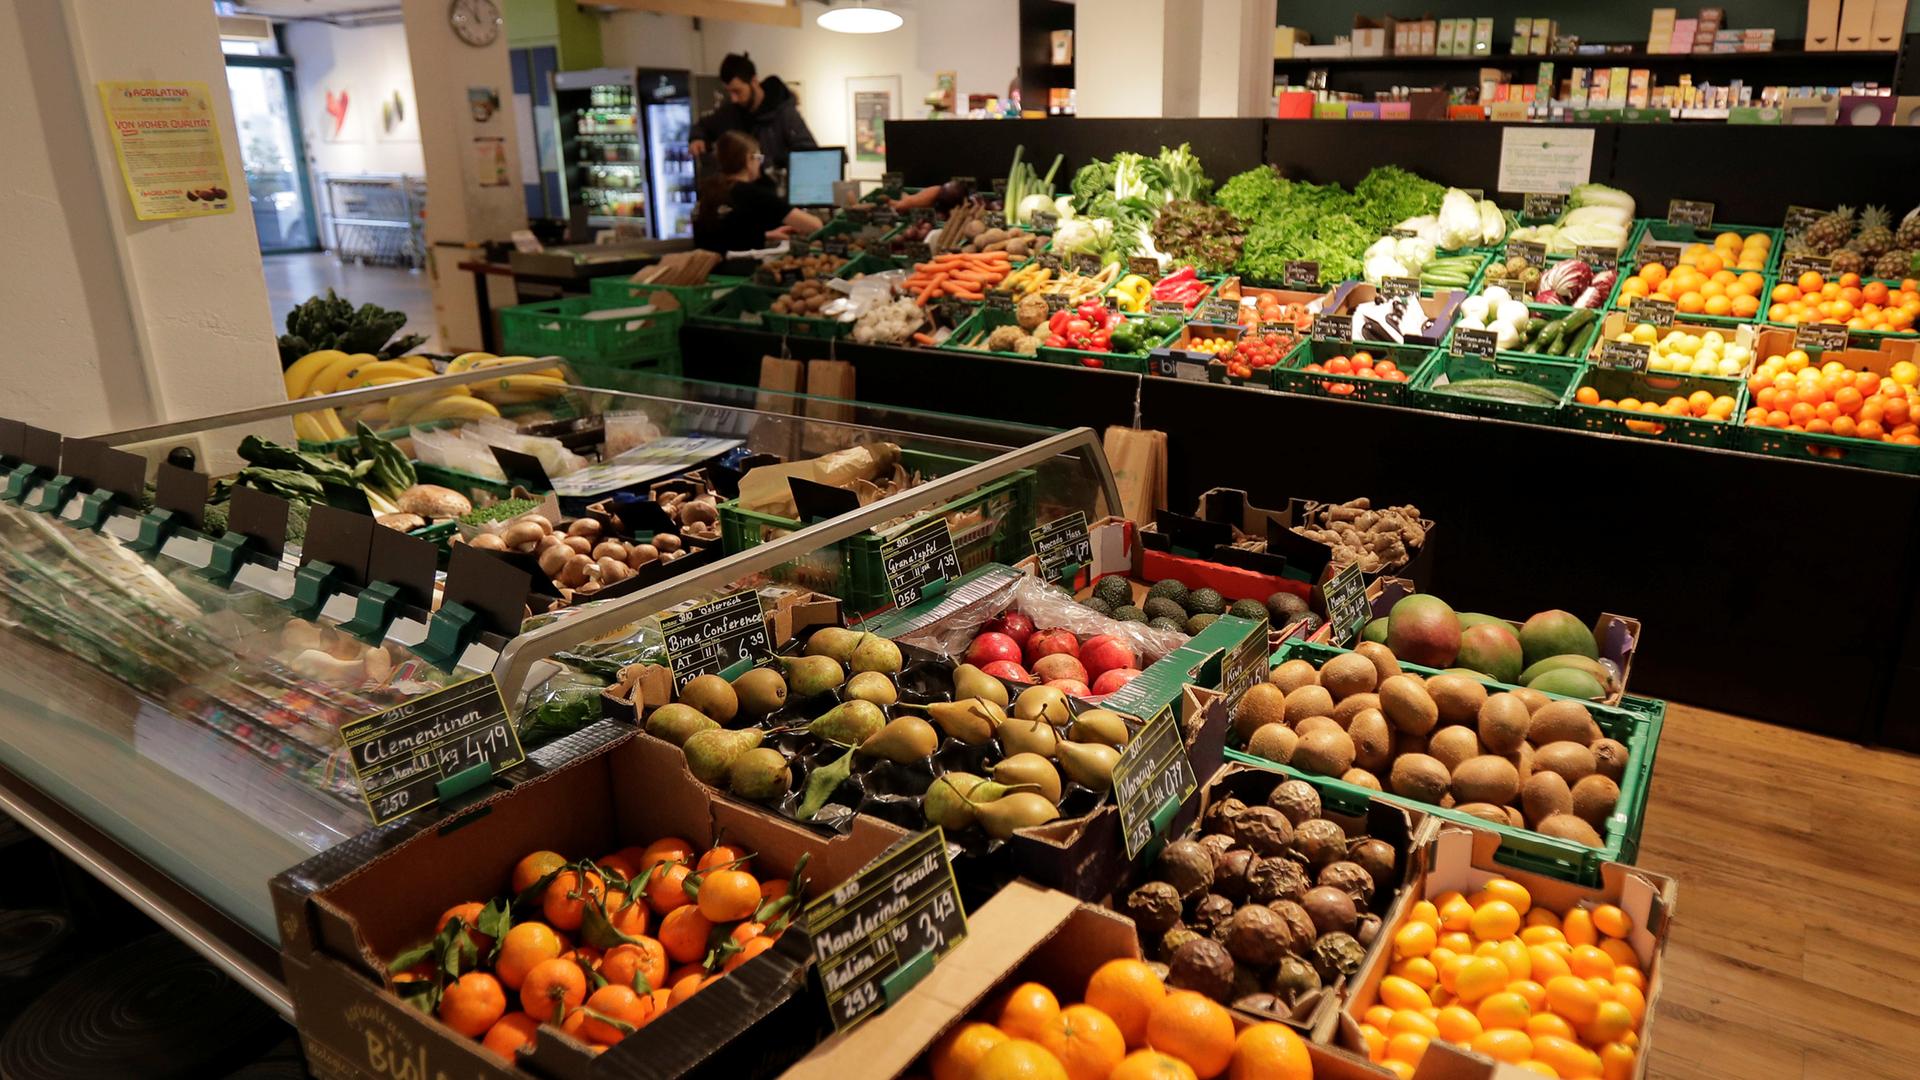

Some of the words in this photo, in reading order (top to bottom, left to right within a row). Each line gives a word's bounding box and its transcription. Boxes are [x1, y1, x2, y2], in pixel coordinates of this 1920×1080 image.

[132, 88, 189, 97] AGRILATINA
[114, 120, 135, 130] VON
[137, 120, 169, 129] HOHER
[170, 118, 210, 128] QUALITÄT
[1039, 533, 1063, 552] Avocado
[1065, 529, 1082, 540] Hass
[888, 540, 937, 573] Granatapfel
[894, 574, 905, 588] IT
[698, 595, 742, 615] Österreich
[898, 588, 916, 606] 256
[668, 633, 702, 652] Birne
[703, 612, 763, 638] Conference
[676, 654, 692, 670] AT
[363, 708, 483, 764] Clementinen
[439, 748, 460, 773] kg
[466, 725, 509, 763] 4,19
[377, 790, 409, 818] 250
[1132, 819, 1152, 853] 253
[833, 881, 860, 906] BIO
[815, 894, 911, 962] Mandarinen
[825, 953, 876, 992] Italien
[843, 984, 878, 1019] 292
